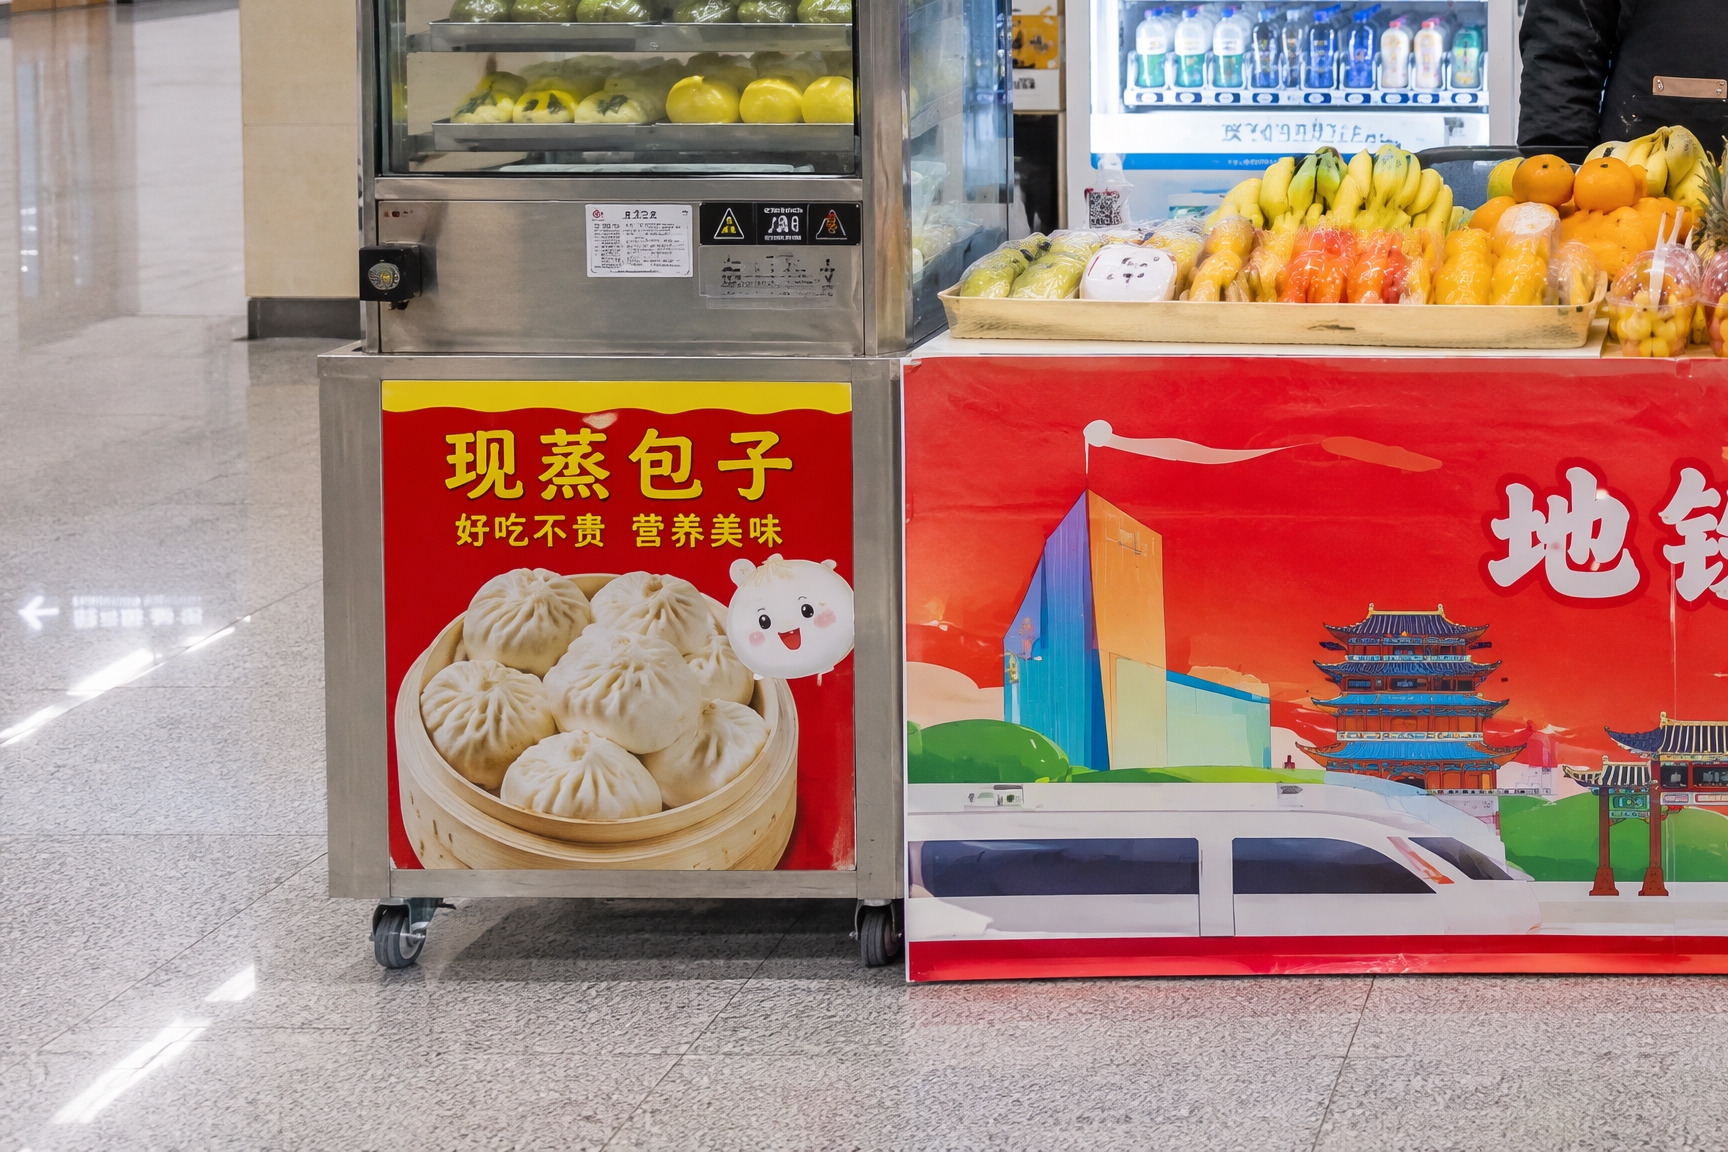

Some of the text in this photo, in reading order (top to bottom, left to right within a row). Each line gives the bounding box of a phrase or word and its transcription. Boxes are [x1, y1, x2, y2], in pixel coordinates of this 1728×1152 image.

[445, 428, 793, 501] 现蒸包子
[455, 512, 783, 548] 好吃不贵 营养美味
